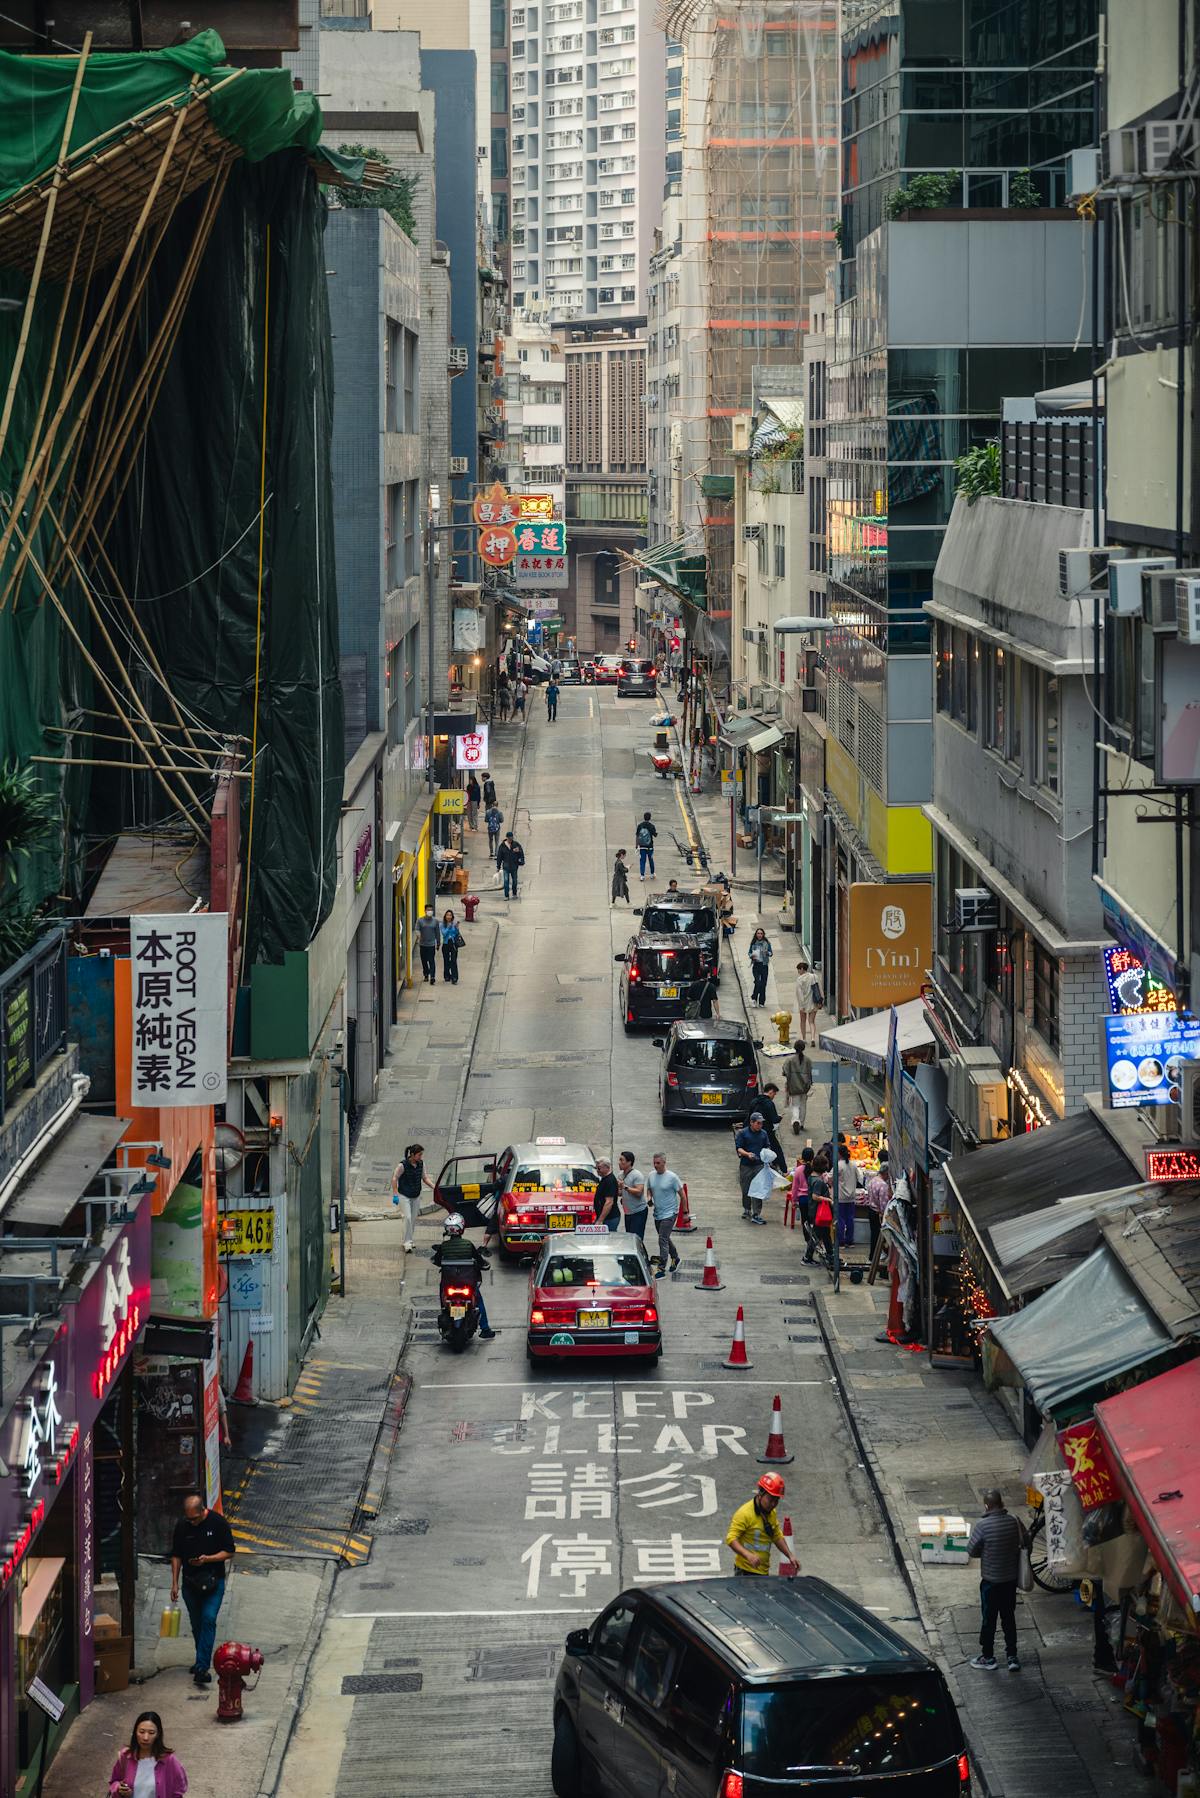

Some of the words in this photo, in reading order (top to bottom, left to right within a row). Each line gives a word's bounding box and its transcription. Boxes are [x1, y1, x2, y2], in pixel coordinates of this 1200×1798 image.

[485, 532, 510, 560] 押
[442, 798, 461, 807] JHC
[176, 931, 196, 998] ROOT
[136, 930, 173, 1092] 本原純素
[176, 1007, 196, 1089] VEGAN
[1153, 1156, 1200, 1175] MASS
[246, 1216, 263, 1244] 4.6
[583, 1319, 605, 1327] 5519
[519, 1391, 716, 1420] KEEP
[524, 1462, 719, 1520] 請勿
[520, 1533, 728, 1598] 停車
